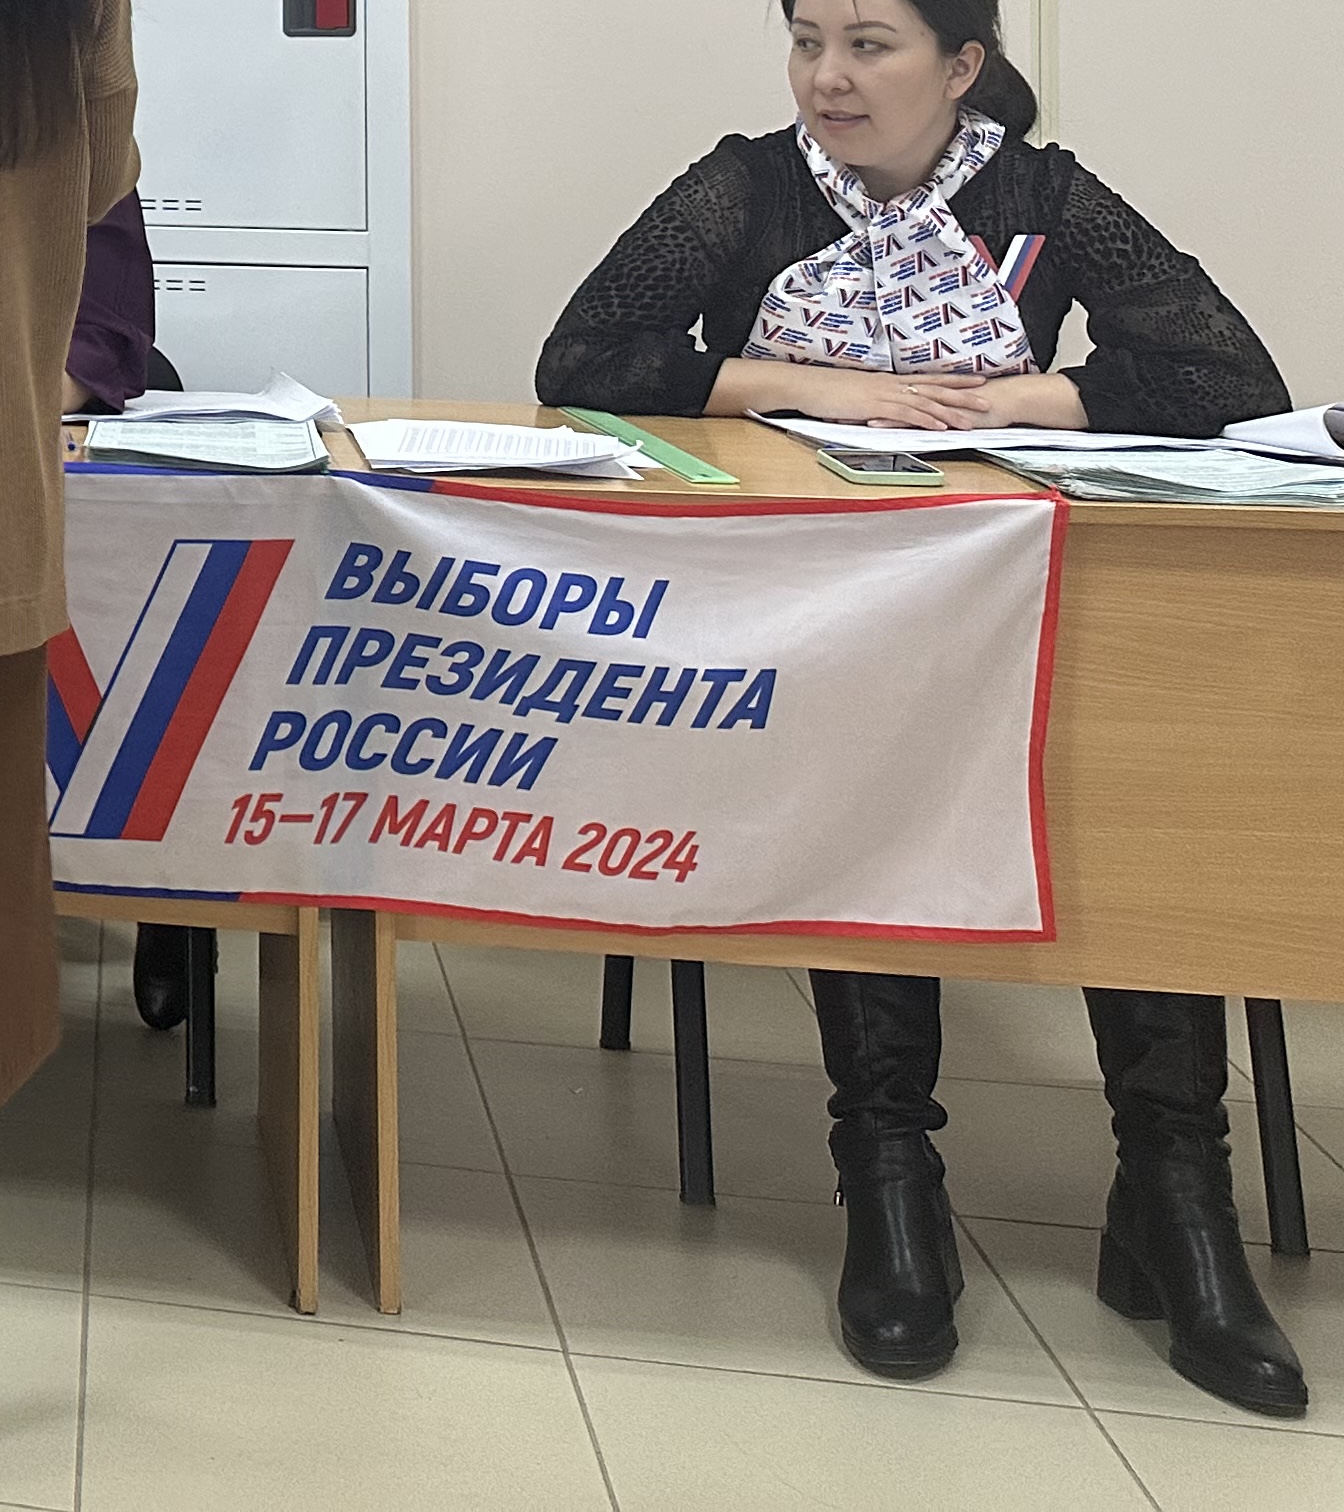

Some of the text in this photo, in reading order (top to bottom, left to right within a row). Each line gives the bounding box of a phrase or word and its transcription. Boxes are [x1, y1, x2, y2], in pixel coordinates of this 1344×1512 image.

[324, 542, 670, 639] ВЫБОРЫ
[285, 626, 779, 731] ПРЕЗИДЕНТА
[248, 709, 557, 792] РОССИИ
[374, 803, 557, 867] МАРТА
[563, 823, 701, 883] 2024
